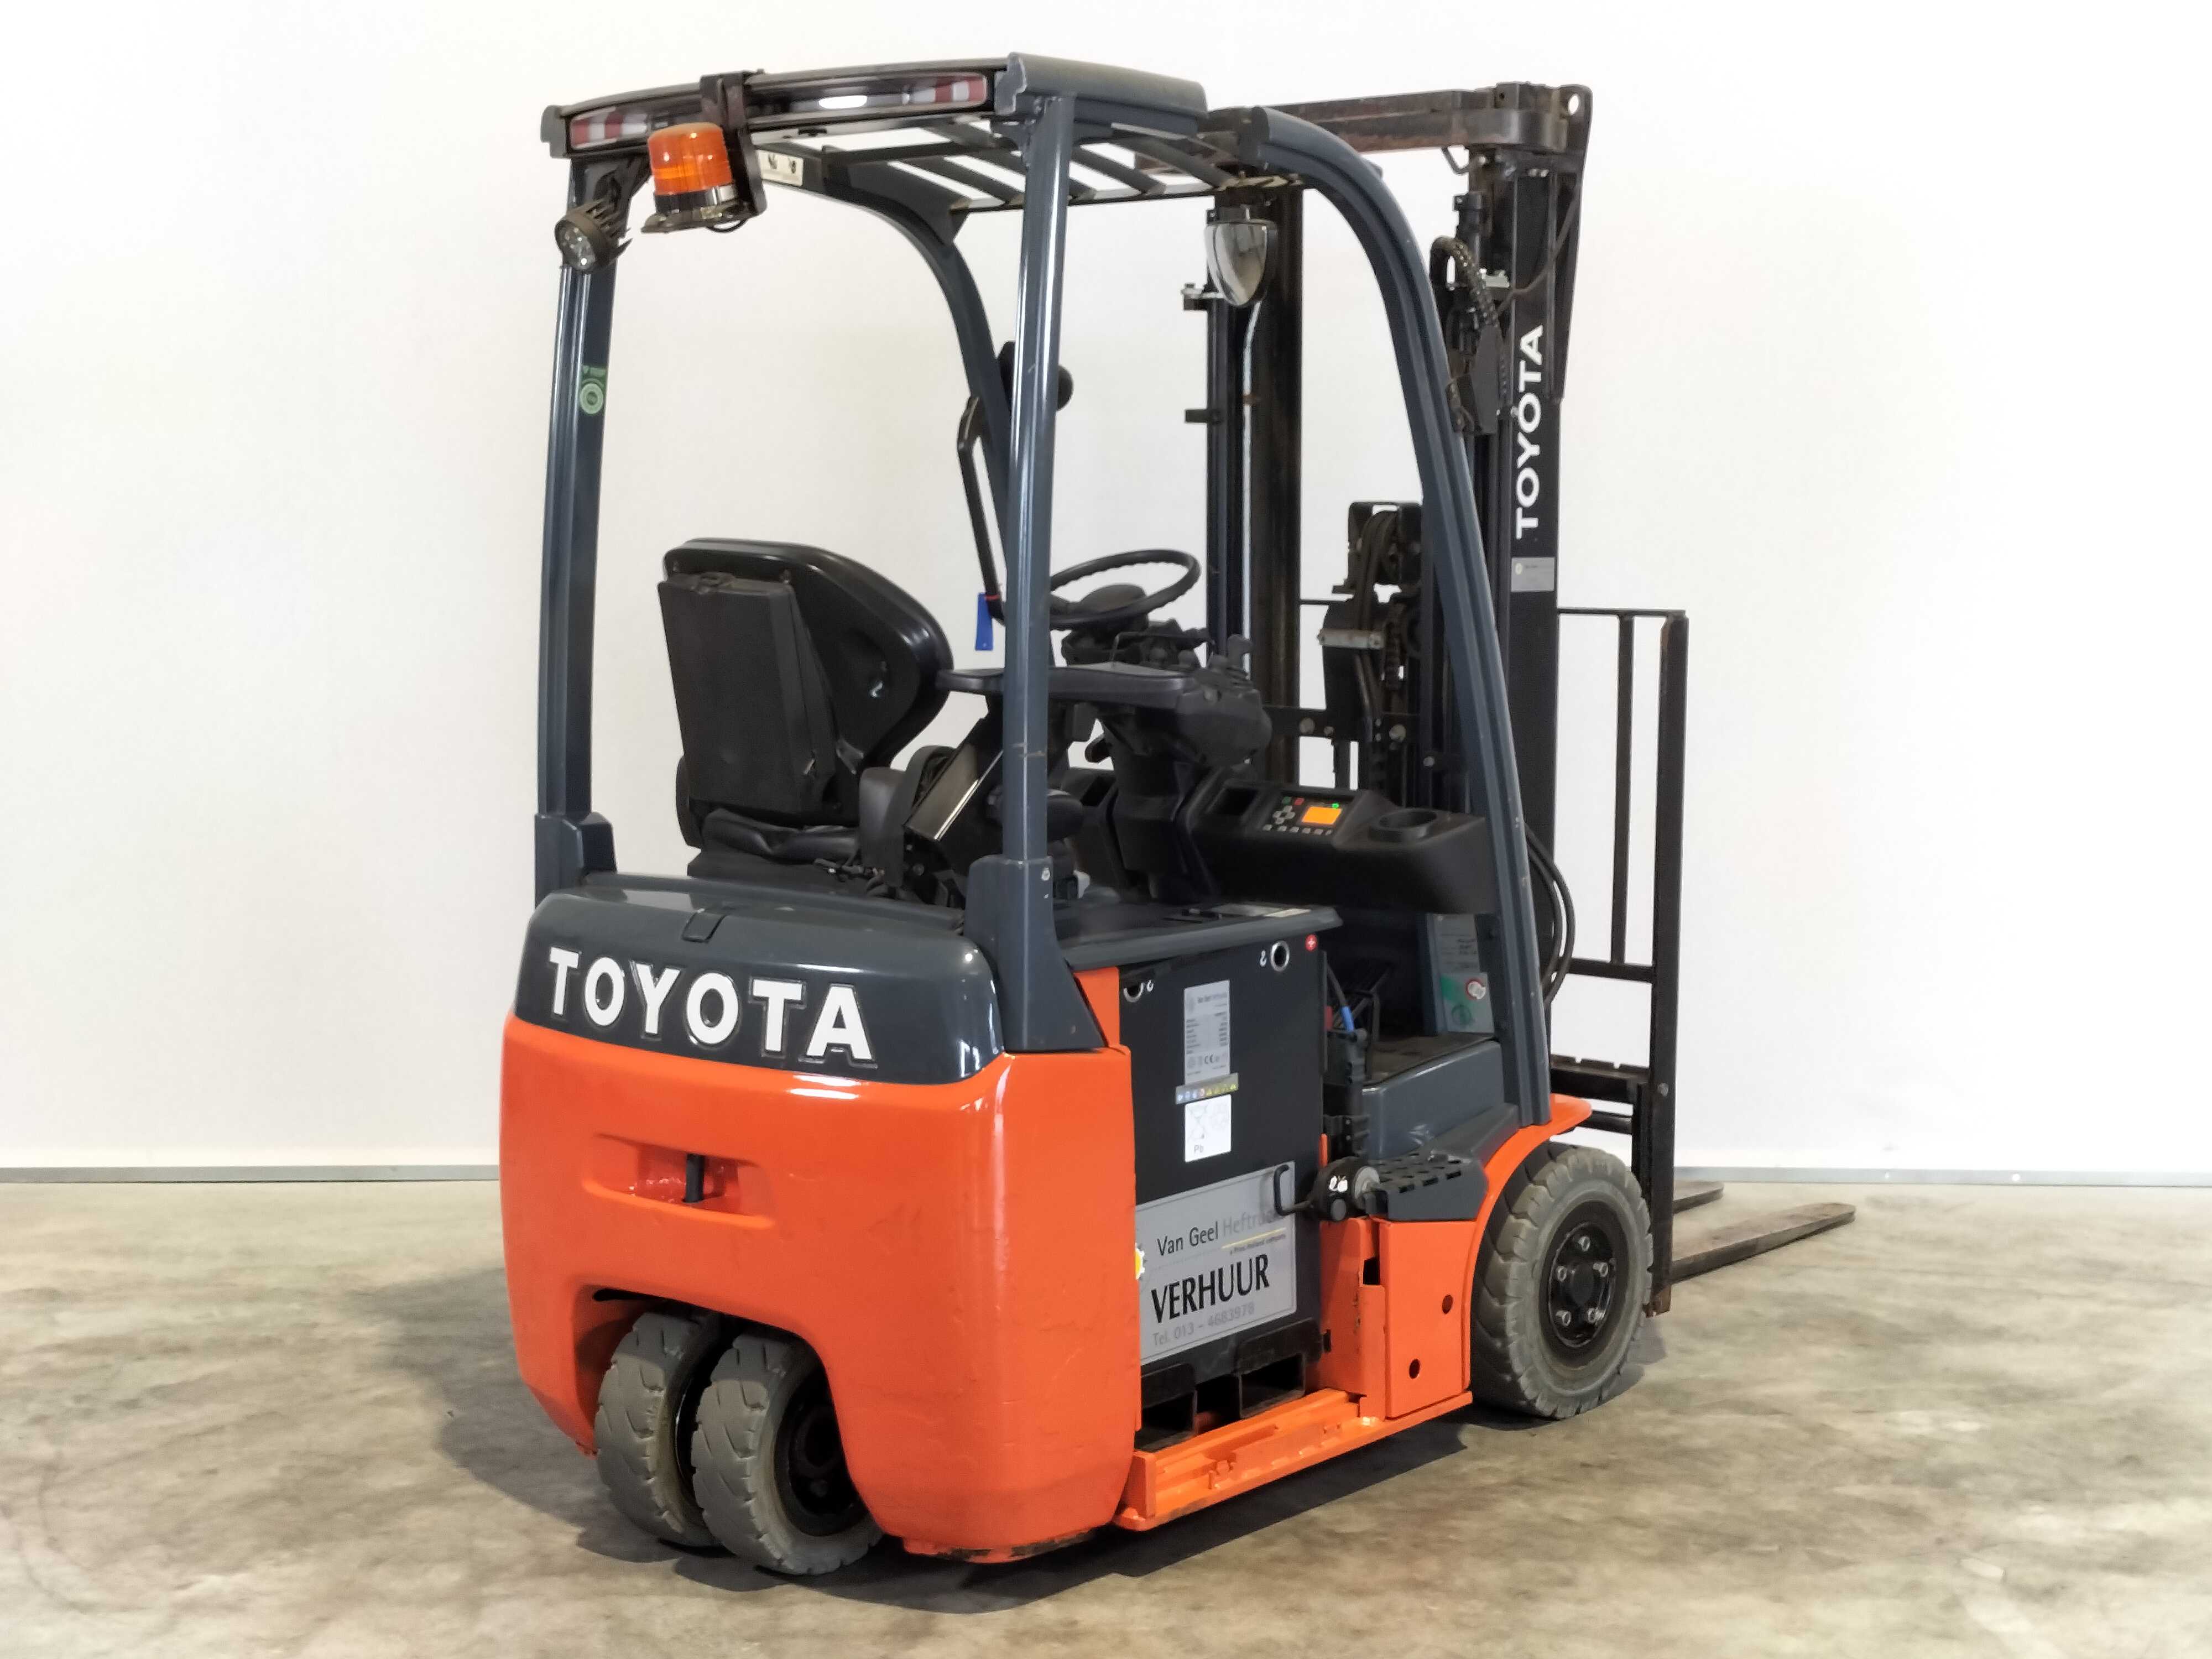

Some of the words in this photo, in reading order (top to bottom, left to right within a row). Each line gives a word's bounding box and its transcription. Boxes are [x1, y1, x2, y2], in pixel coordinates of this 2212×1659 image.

[1516, 325, 1543, 539] TOYOTA
[549, 947, 874, 1060] TOYOTA
[1157, 1235, 1183, 1256] Van
[1190, 1221, 1218, 1247] Geel
[1151, 1254, 1270, 1324] VERHUUR
[1173, 1322, 1194, 1339] 013
